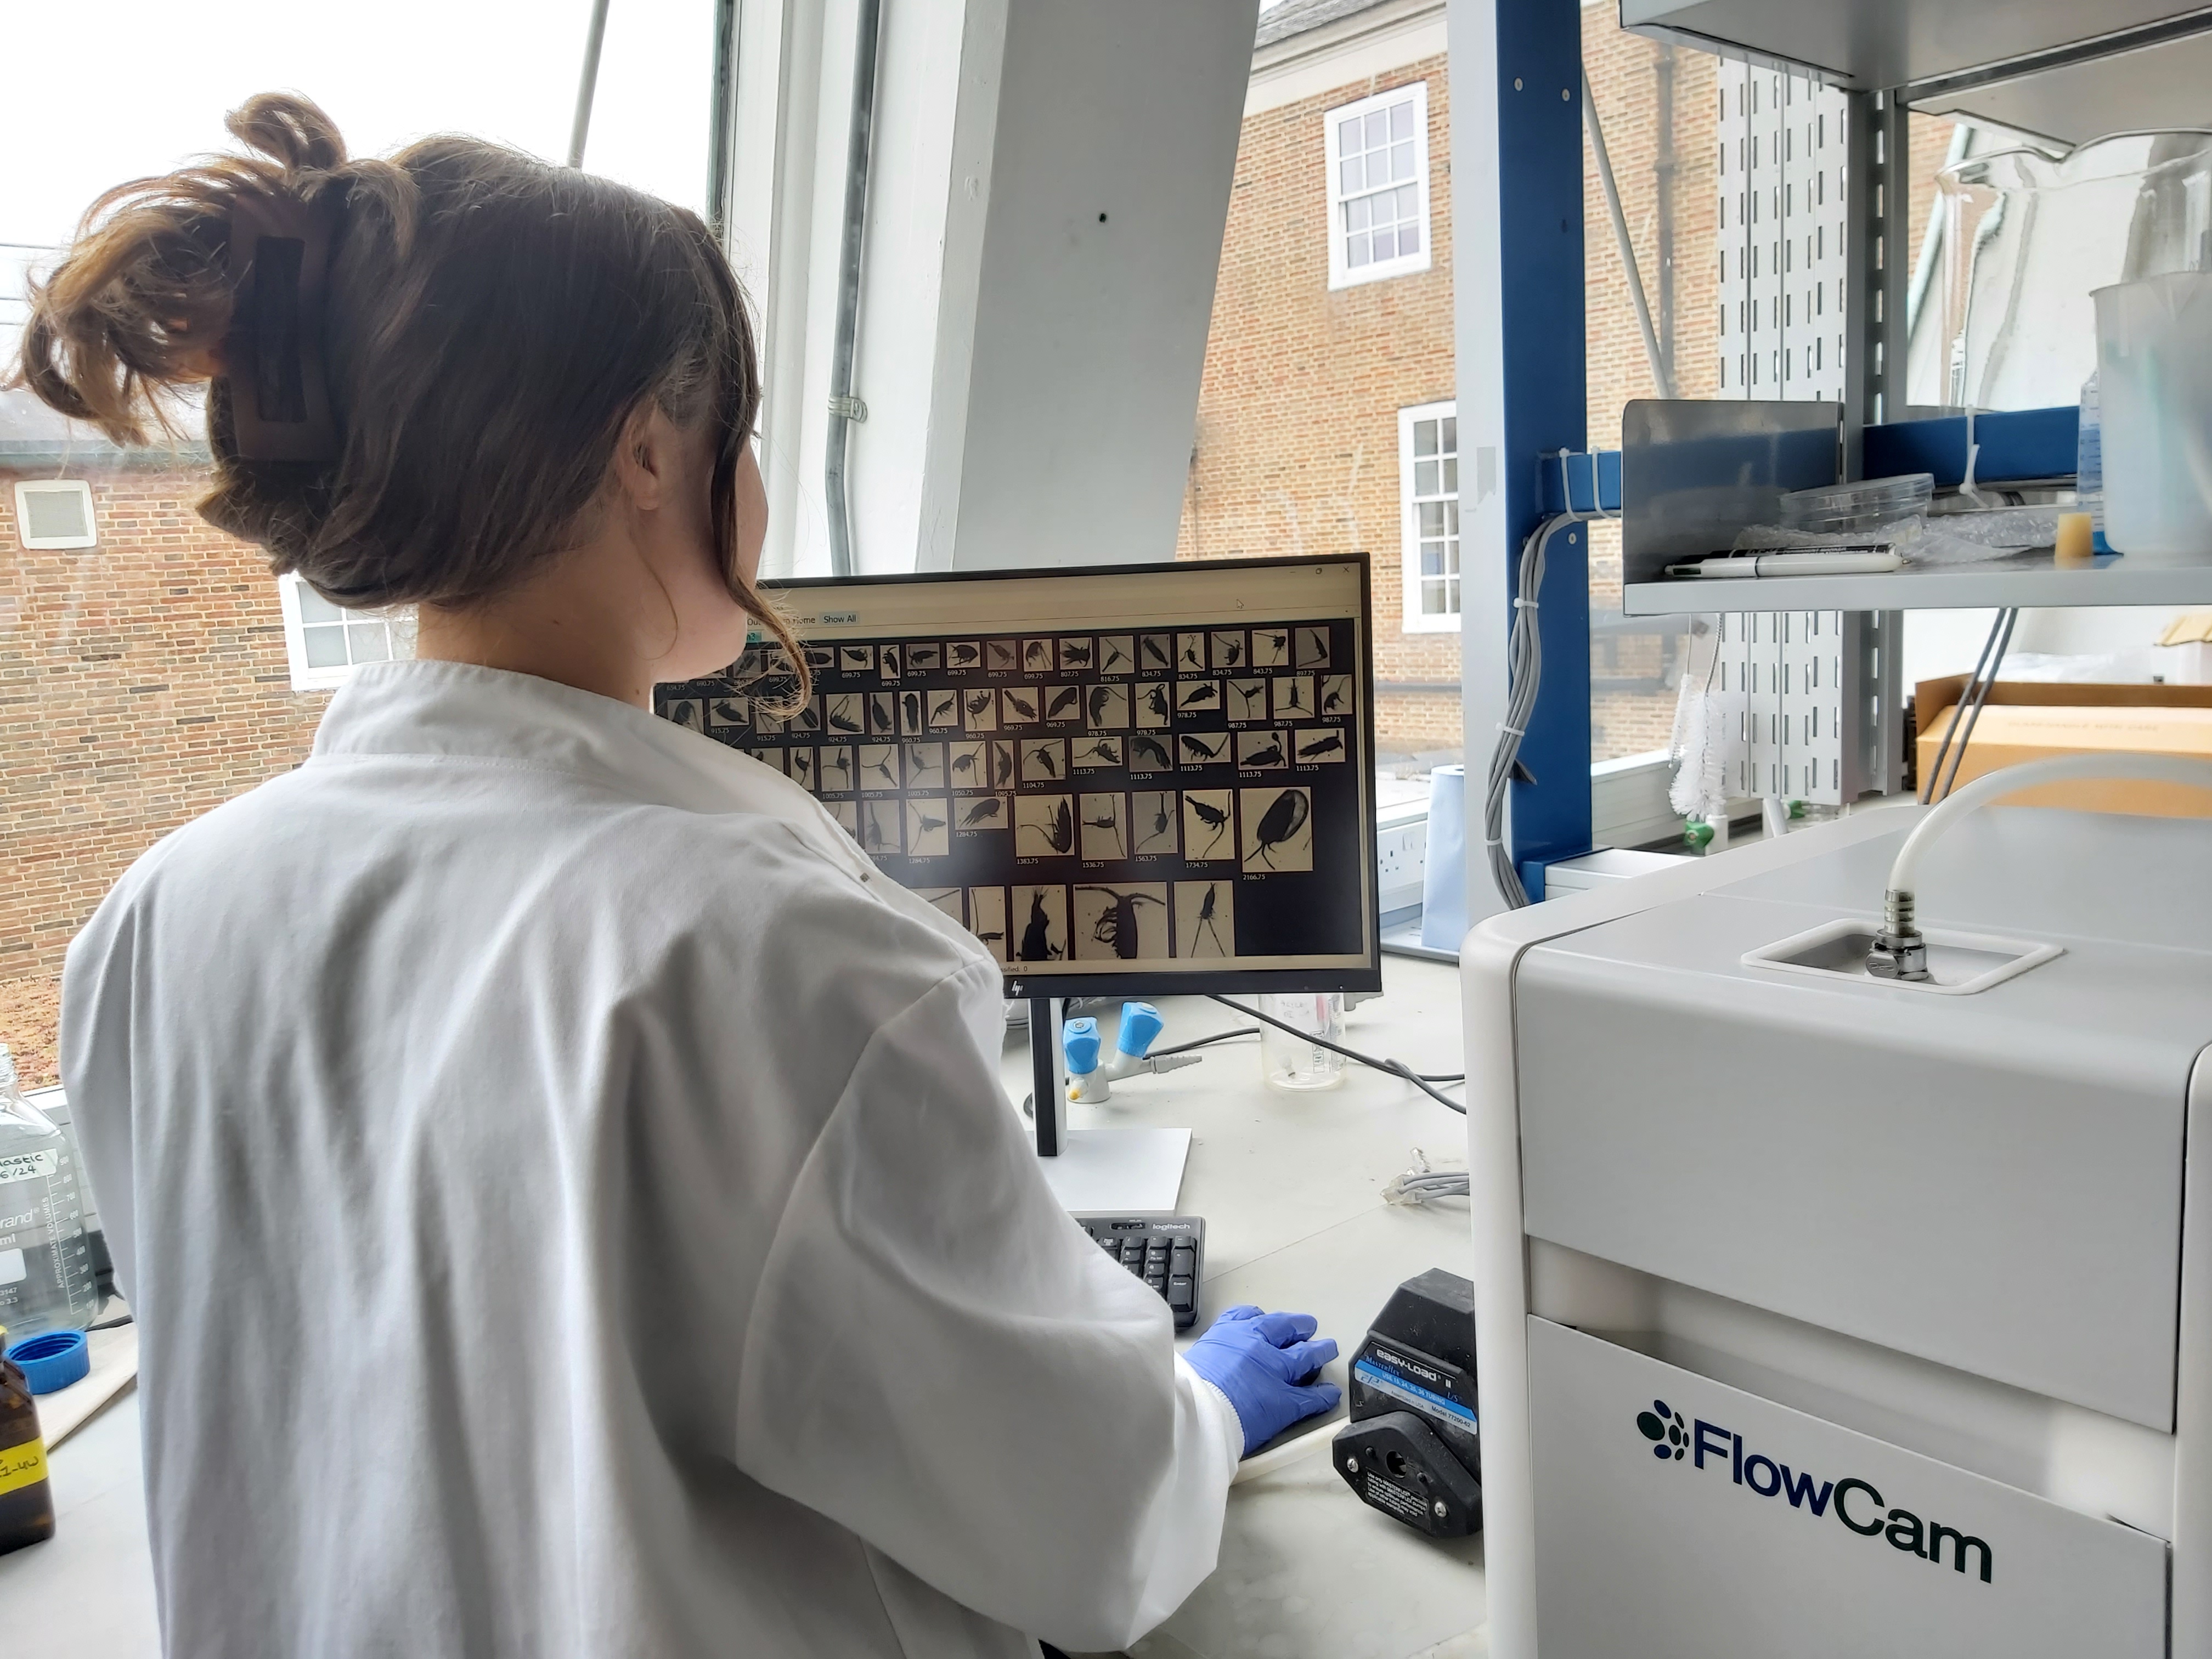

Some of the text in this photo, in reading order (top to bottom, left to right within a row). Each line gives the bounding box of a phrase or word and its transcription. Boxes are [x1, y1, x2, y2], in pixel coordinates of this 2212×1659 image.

[0, 1154, 43, 1167] lastic
[0, 1165, 36, 1179] 6/24
[42, 1197, 65, 1288] APPROXIMATE VOLUMES
[0, 1287, 18, 1296] 3147
[82, 1281, 92, 1293] 200
[1382, 1372, 1392, 1381] USE
[1426, 1392, 1446, 1406] TUBING
[1431, 1405, 1471, 1428] Model 77200-62
[1694, 1418, 1991, 1583] FlowCam
